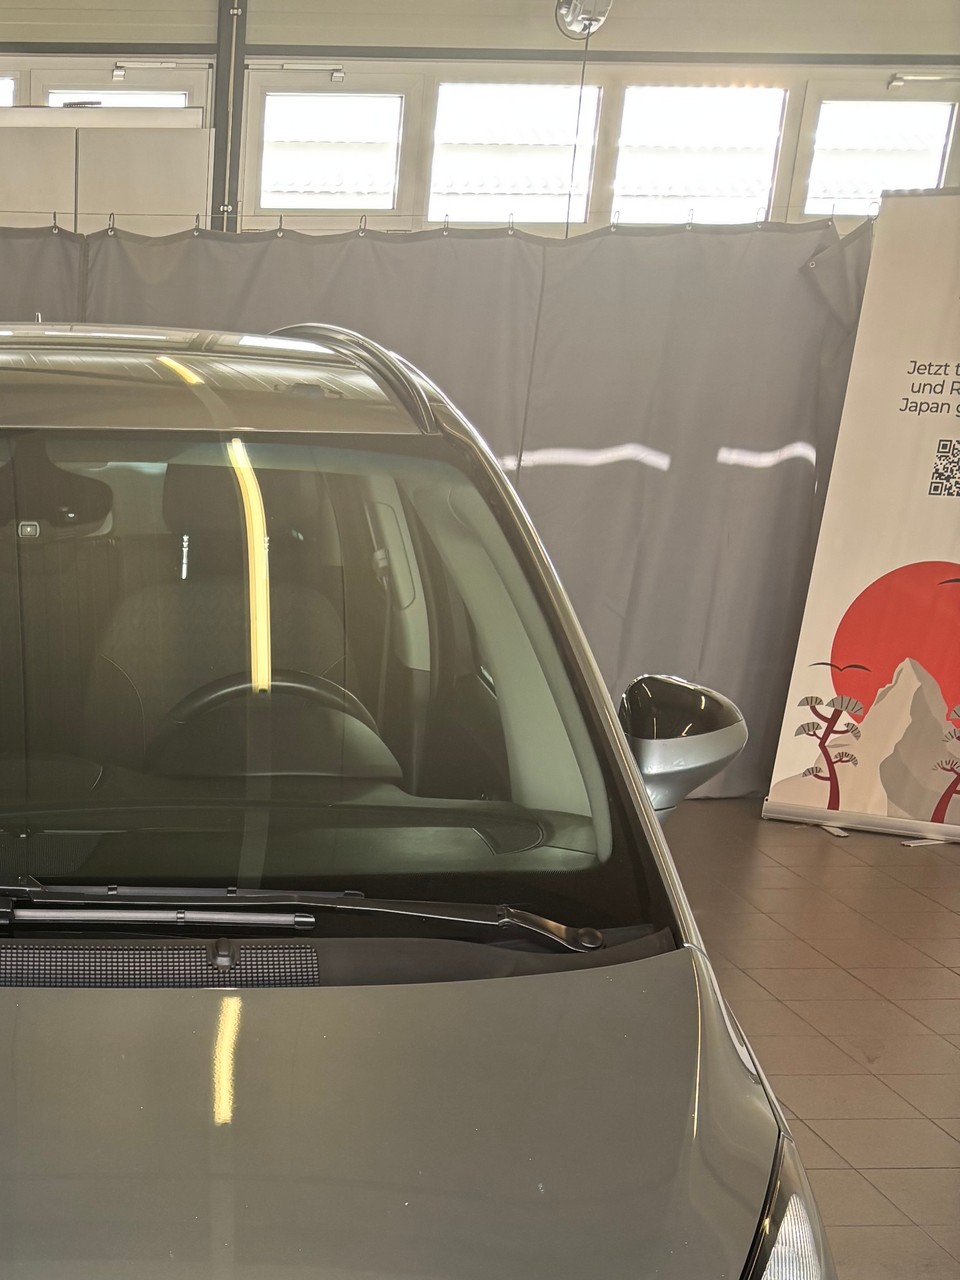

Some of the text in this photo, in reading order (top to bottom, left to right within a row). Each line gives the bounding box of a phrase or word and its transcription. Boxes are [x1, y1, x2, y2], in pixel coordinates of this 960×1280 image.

[907, 360, 950, 376] Jetzt
[911, 379, 945, 394] und
[899, 397, 951, 416] Japan
